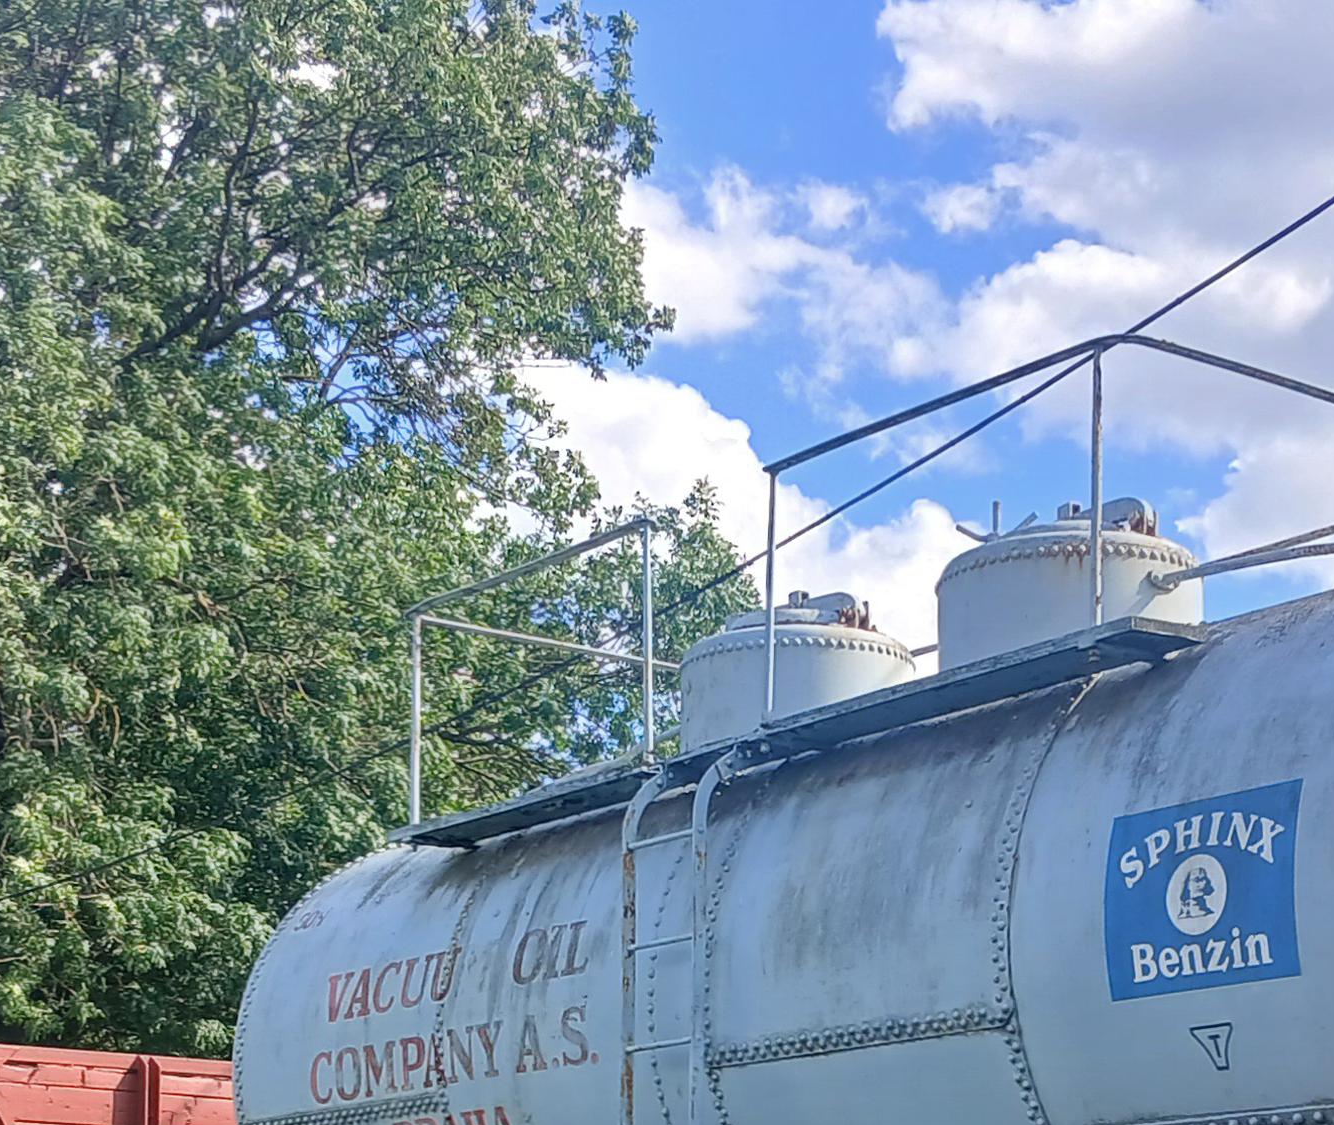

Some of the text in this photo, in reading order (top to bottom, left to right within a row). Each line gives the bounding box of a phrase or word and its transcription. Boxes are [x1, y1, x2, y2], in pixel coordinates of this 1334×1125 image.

[1119, 811, 1284, 889] SPHINX
[328, 920, 588, 1023] VACUU OIL
[1130, 927, 1273, 985] Benzin
[310, 1006, 600, 1104] COMPANY A.S.
